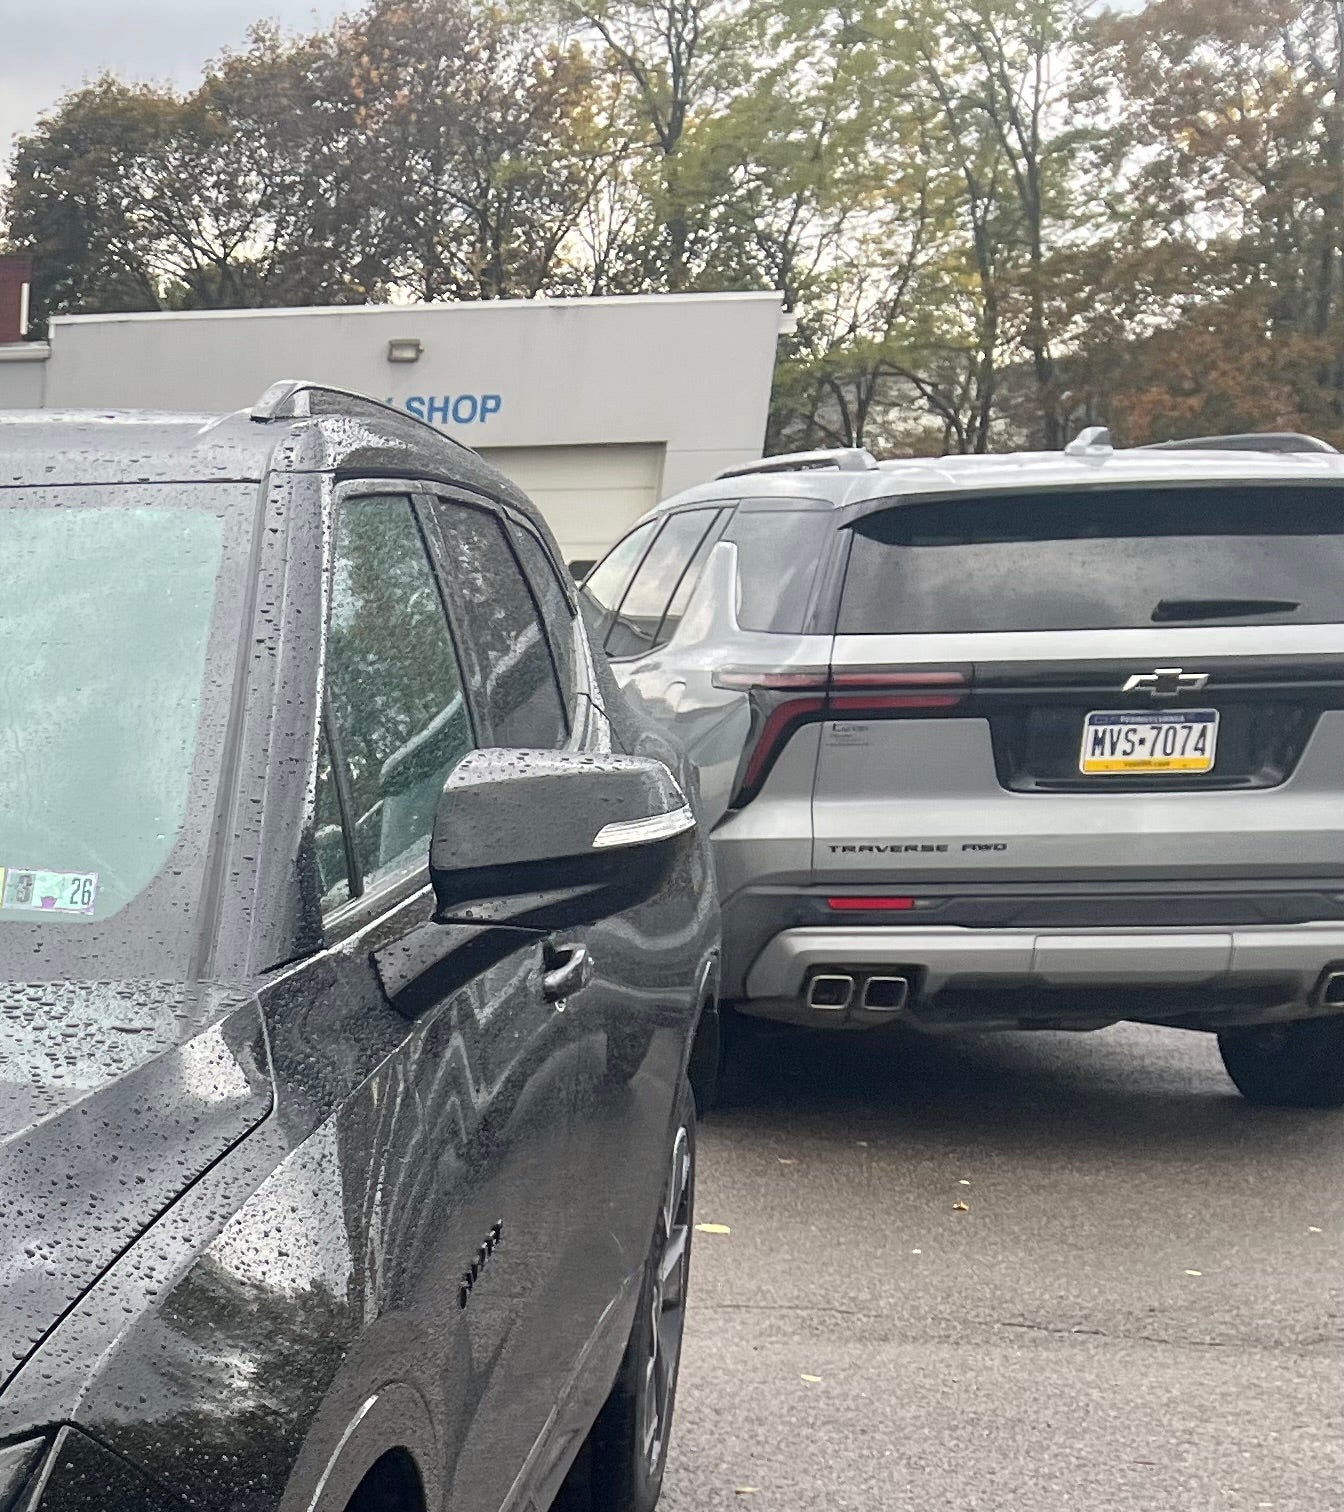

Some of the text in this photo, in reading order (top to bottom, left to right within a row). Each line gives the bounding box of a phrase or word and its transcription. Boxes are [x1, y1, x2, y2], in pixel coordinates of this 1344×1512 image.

[828, 842, 1008, 854] TRAVERSE AWD
[69, 878, 93, 906] 26
